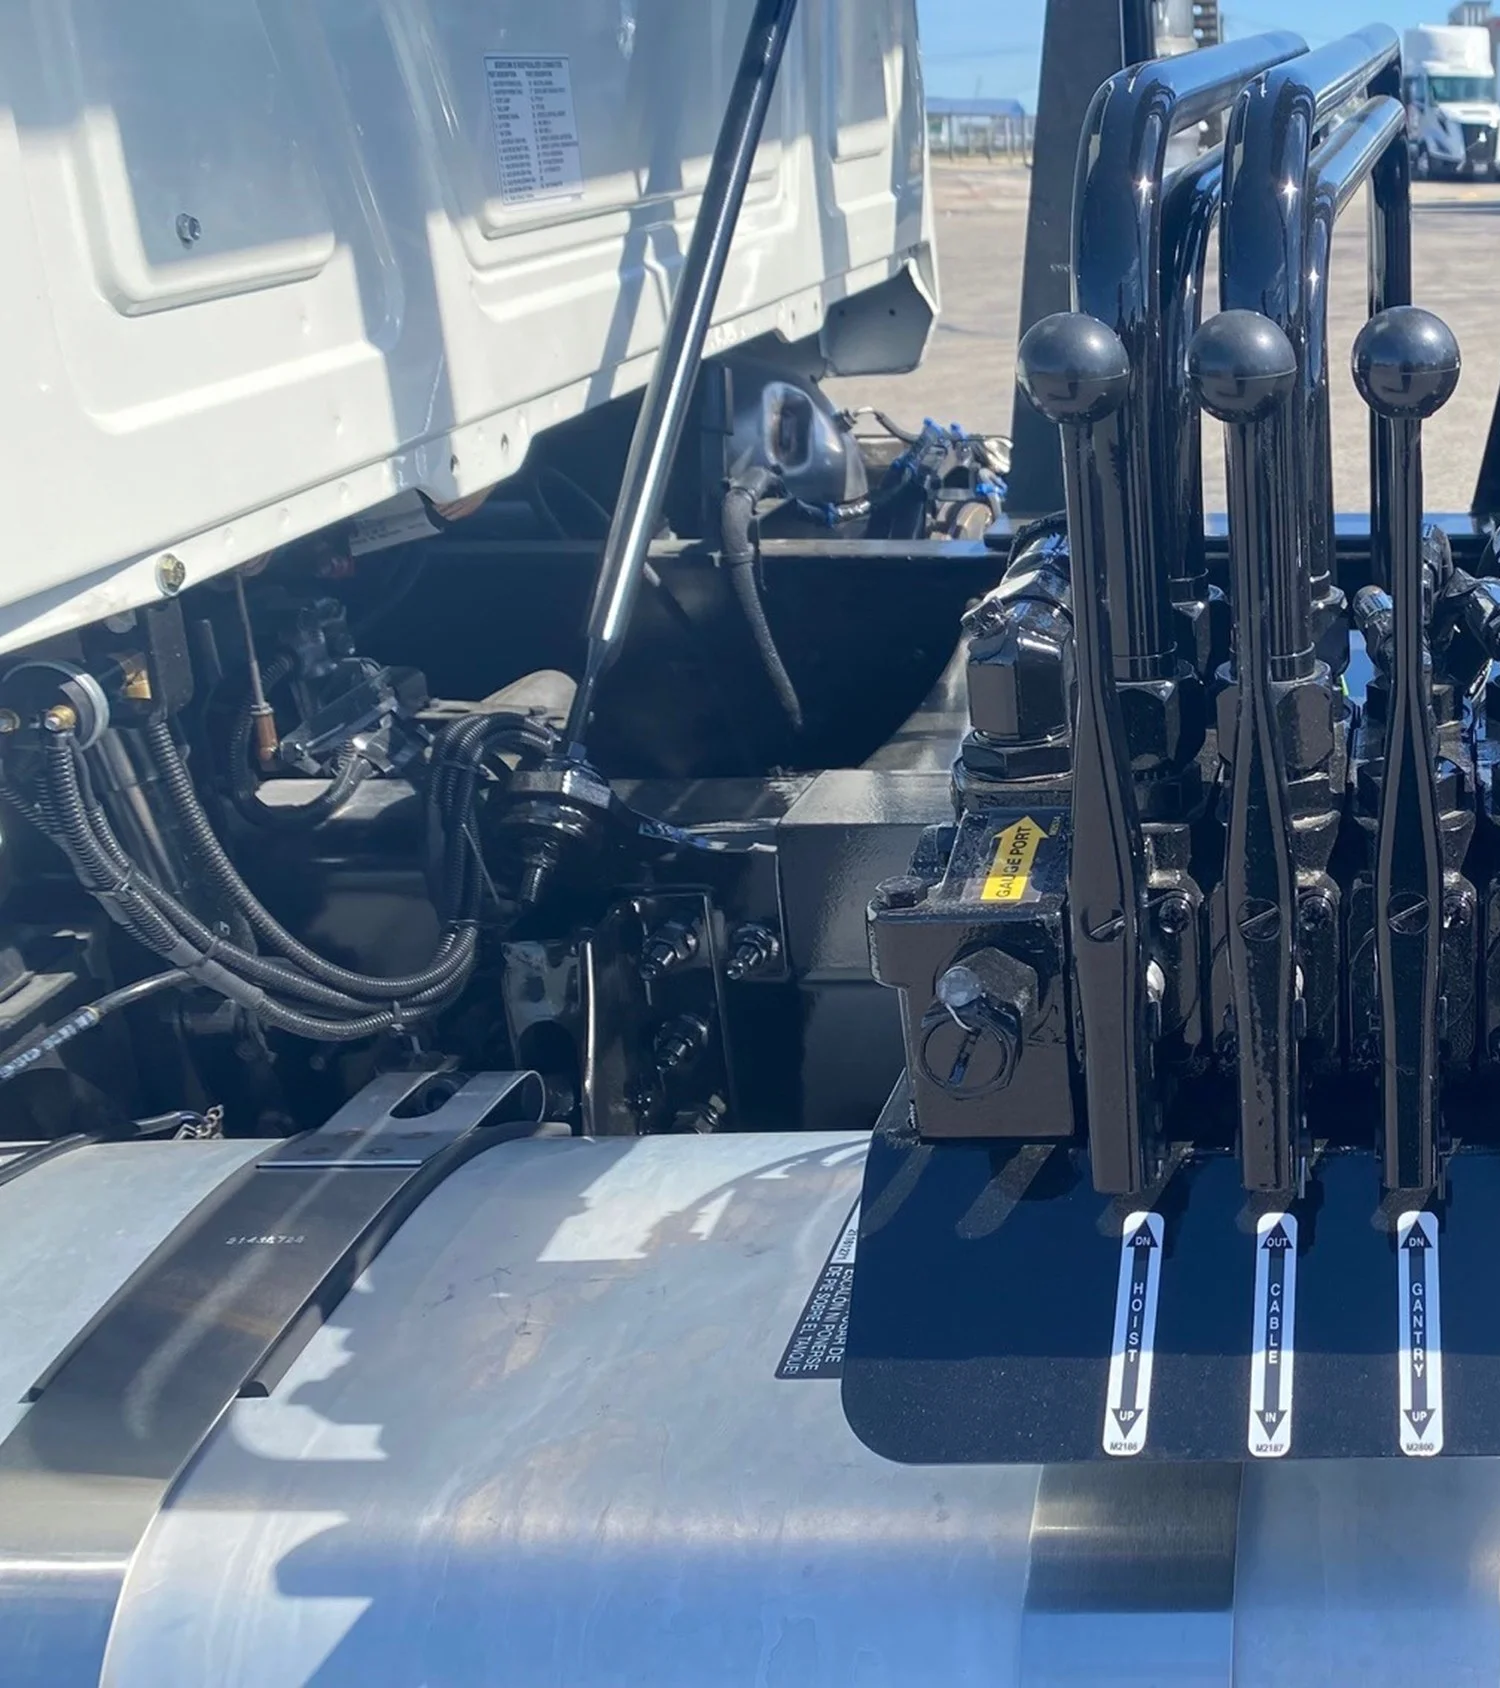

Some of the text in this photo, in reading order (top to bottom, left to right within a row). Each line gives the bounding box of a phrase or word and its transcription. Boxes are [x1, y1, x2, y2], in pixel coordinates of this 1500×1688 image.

[995, 826, 1033, 898] GAUGE PORT
[1135, 1236, 1151, 1246] DN
[1266, 1237, 1288, 1247] OUT
[1409, 1237, 1424, 1247] DN
[825, 1265, 843, 1278] DE
[819, 1278, 837, 1292] PIE
[806, 1293, 831, 1322] SOBRE
[799, 1322, 817, 1334] EL
[1128, 1283, 1144, 1362] HOIST
[1268, 1283, 1281, 1364] CABLE
[1412, 1283, 1424, 1378] GANTRY
[803, 1324, 835, 1372] PONERSE
[825, 1347, 845, 1363] DE
[1119, 1410, 1135, 1421] UP
[1265, 1411, 1276, 1422] IN
[1412, 1411, 1427, 1421] UP
